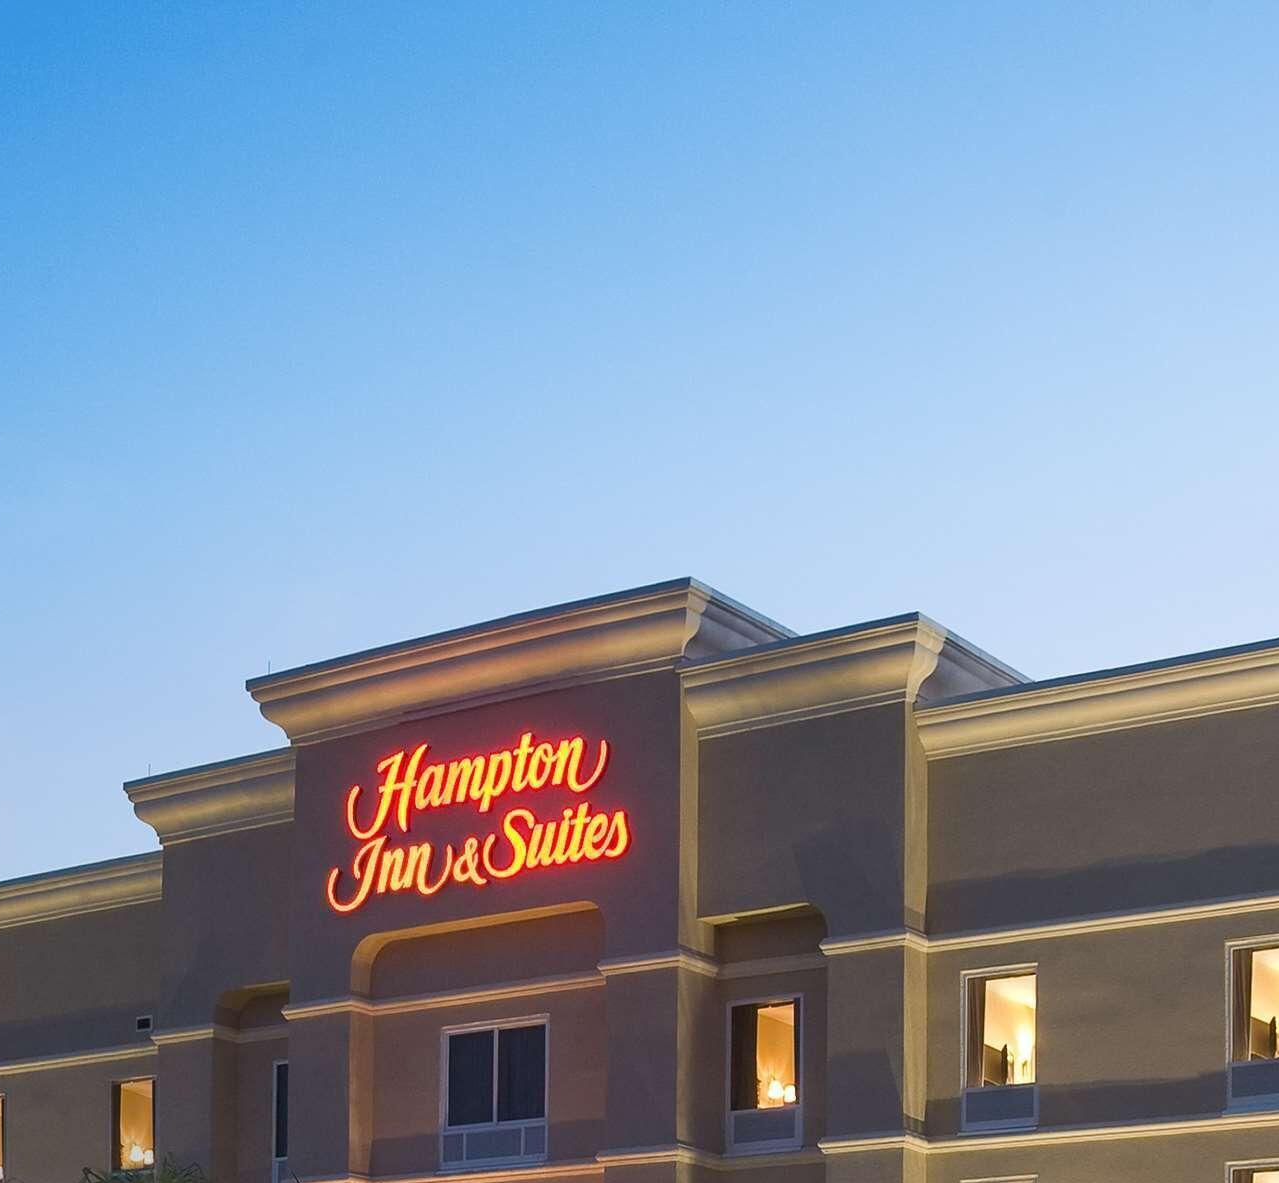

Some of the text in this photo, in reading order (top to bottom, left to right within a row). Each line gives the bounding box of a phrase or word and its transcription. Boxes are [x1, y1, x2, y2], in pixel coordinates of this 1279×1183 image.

[346, 731, 609, 841] Hampton
[326, 801, 631, 913] Inn & Suites
